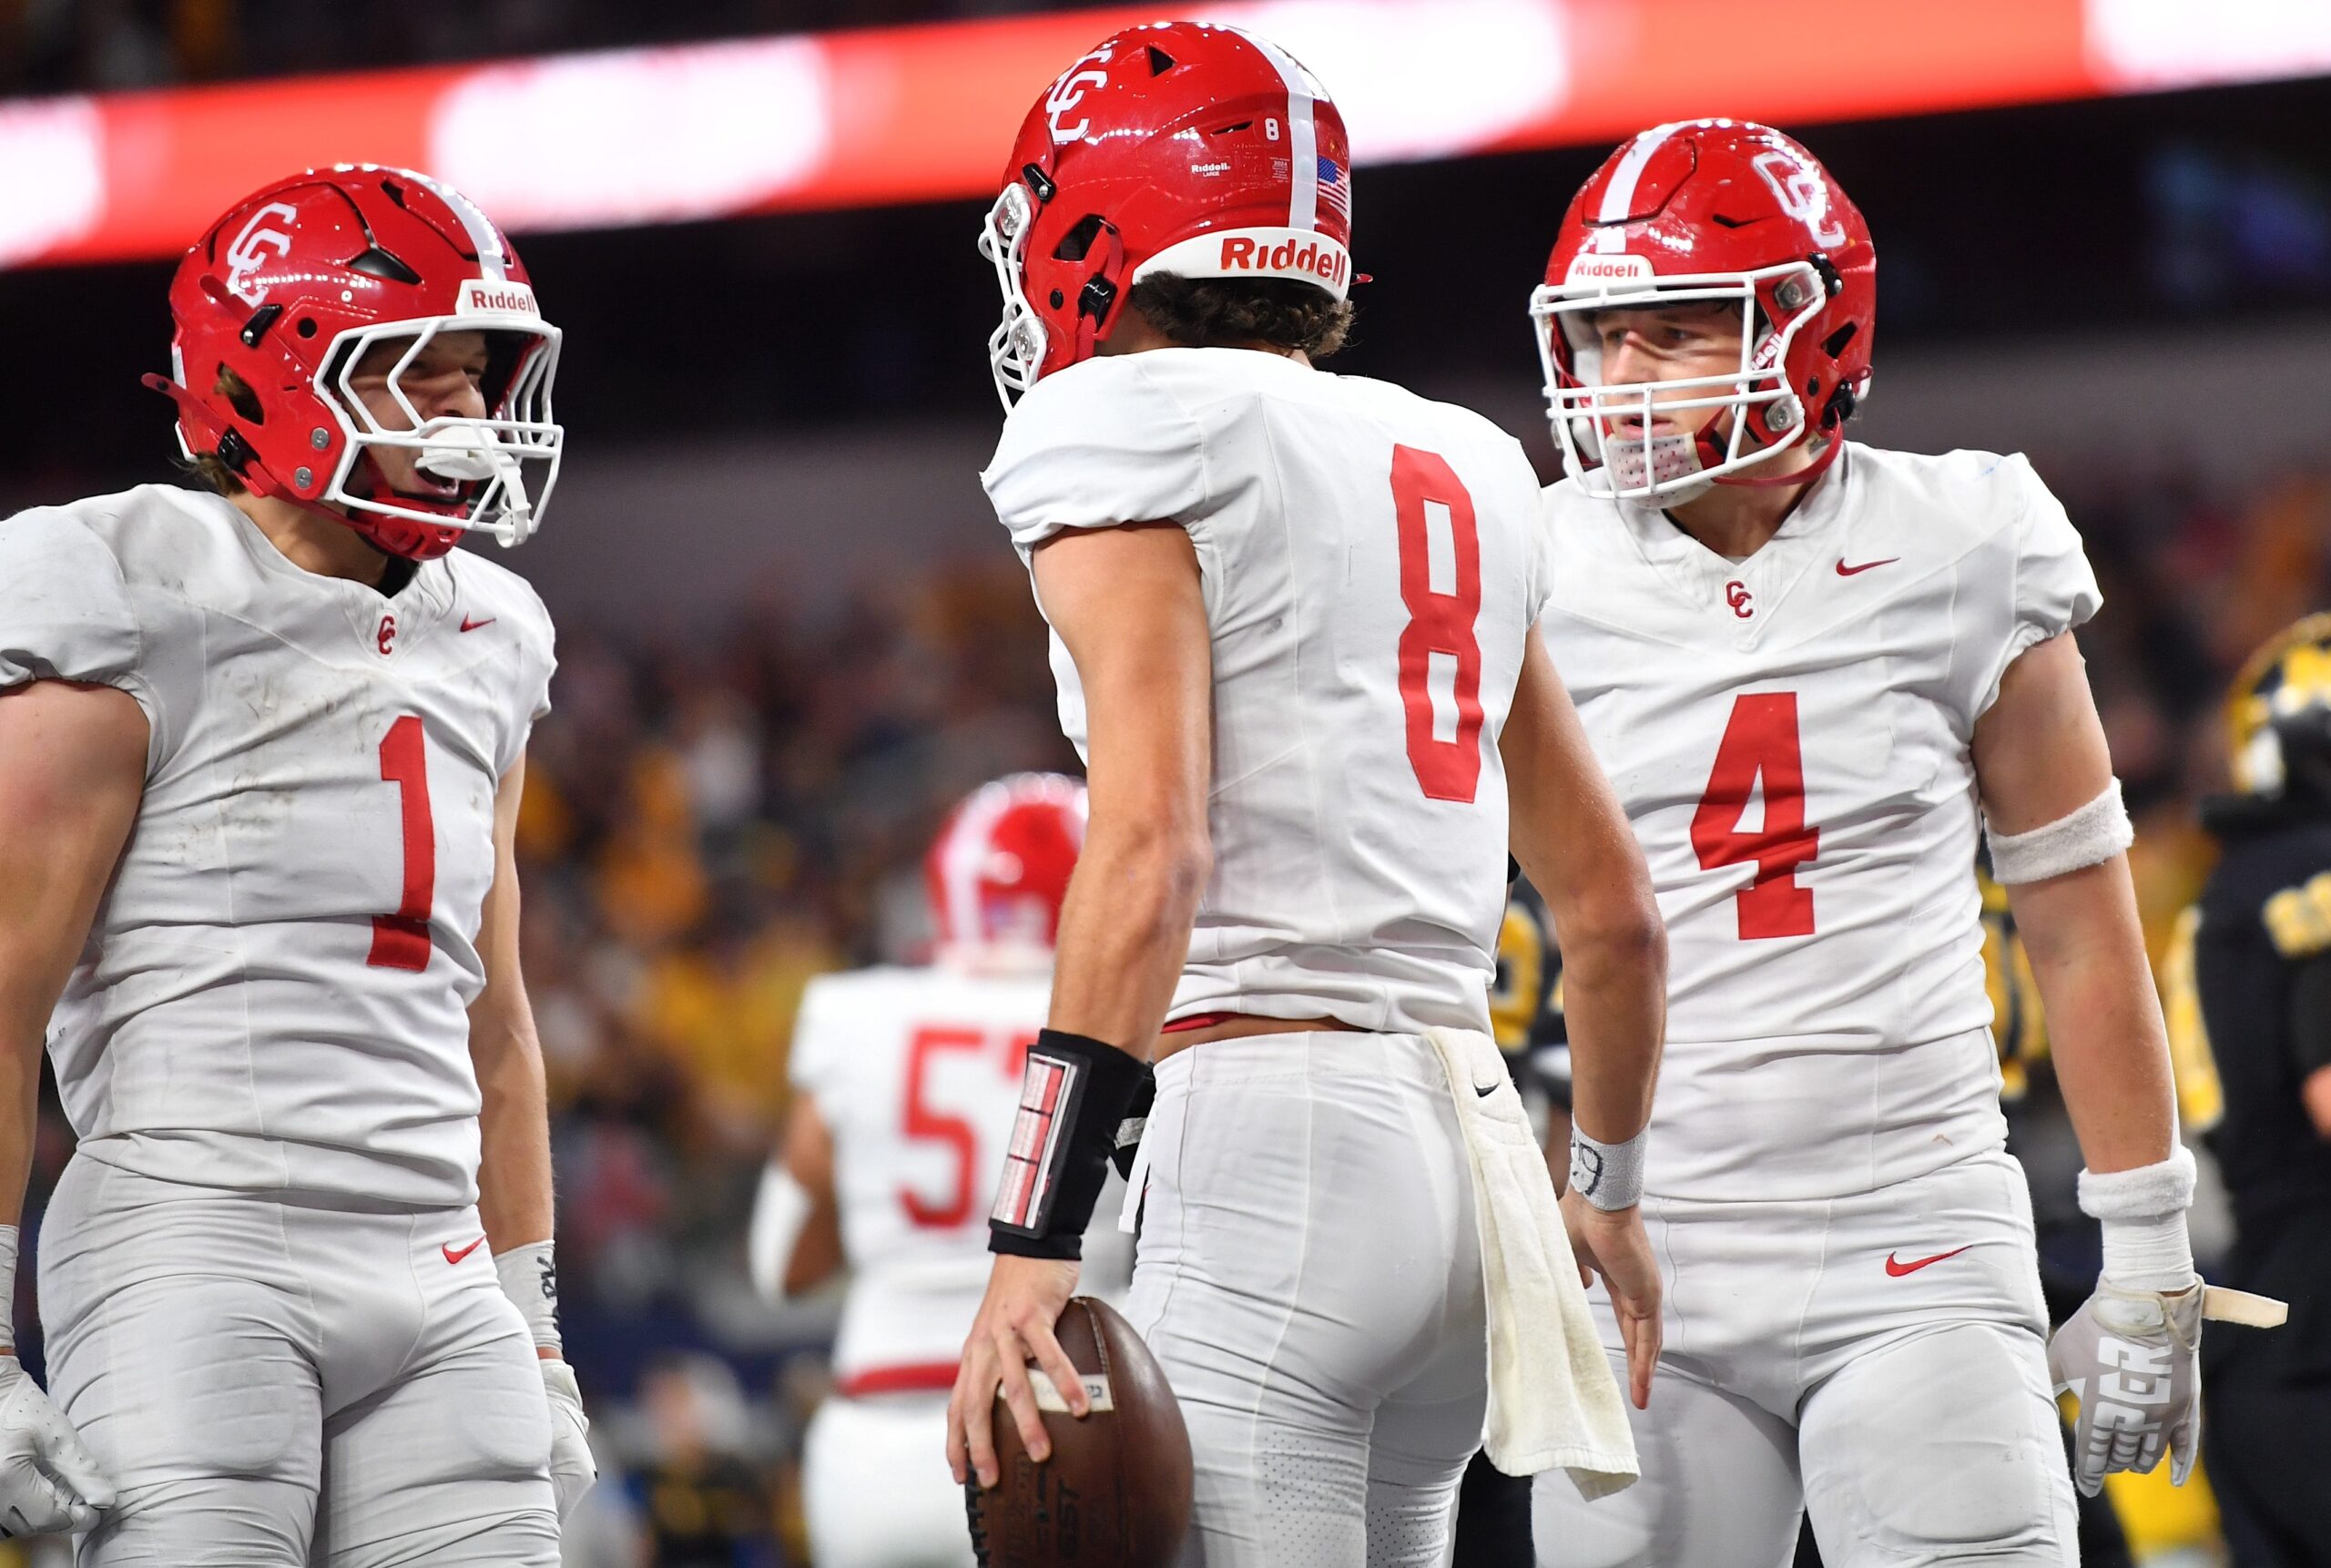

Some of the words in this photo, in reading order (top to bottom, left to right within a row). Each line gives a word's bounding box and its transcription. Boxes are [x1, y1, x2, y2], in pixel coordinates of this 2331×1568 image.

[1265, 118, 1279, 140] 8
[1191, 162, 1227, 173] Riddell
[1220, 238, 1347, 289] Riddell
[1575, 260, 1639, 277] Riddell
[471, 290, 535, 313] Riddell
[1389, 443, 1484, 803] 8
[1691, 691, 1819, 940] 4
[367, 715, 435, 972] 1
[898, 1026, 1038, 1229] 5
